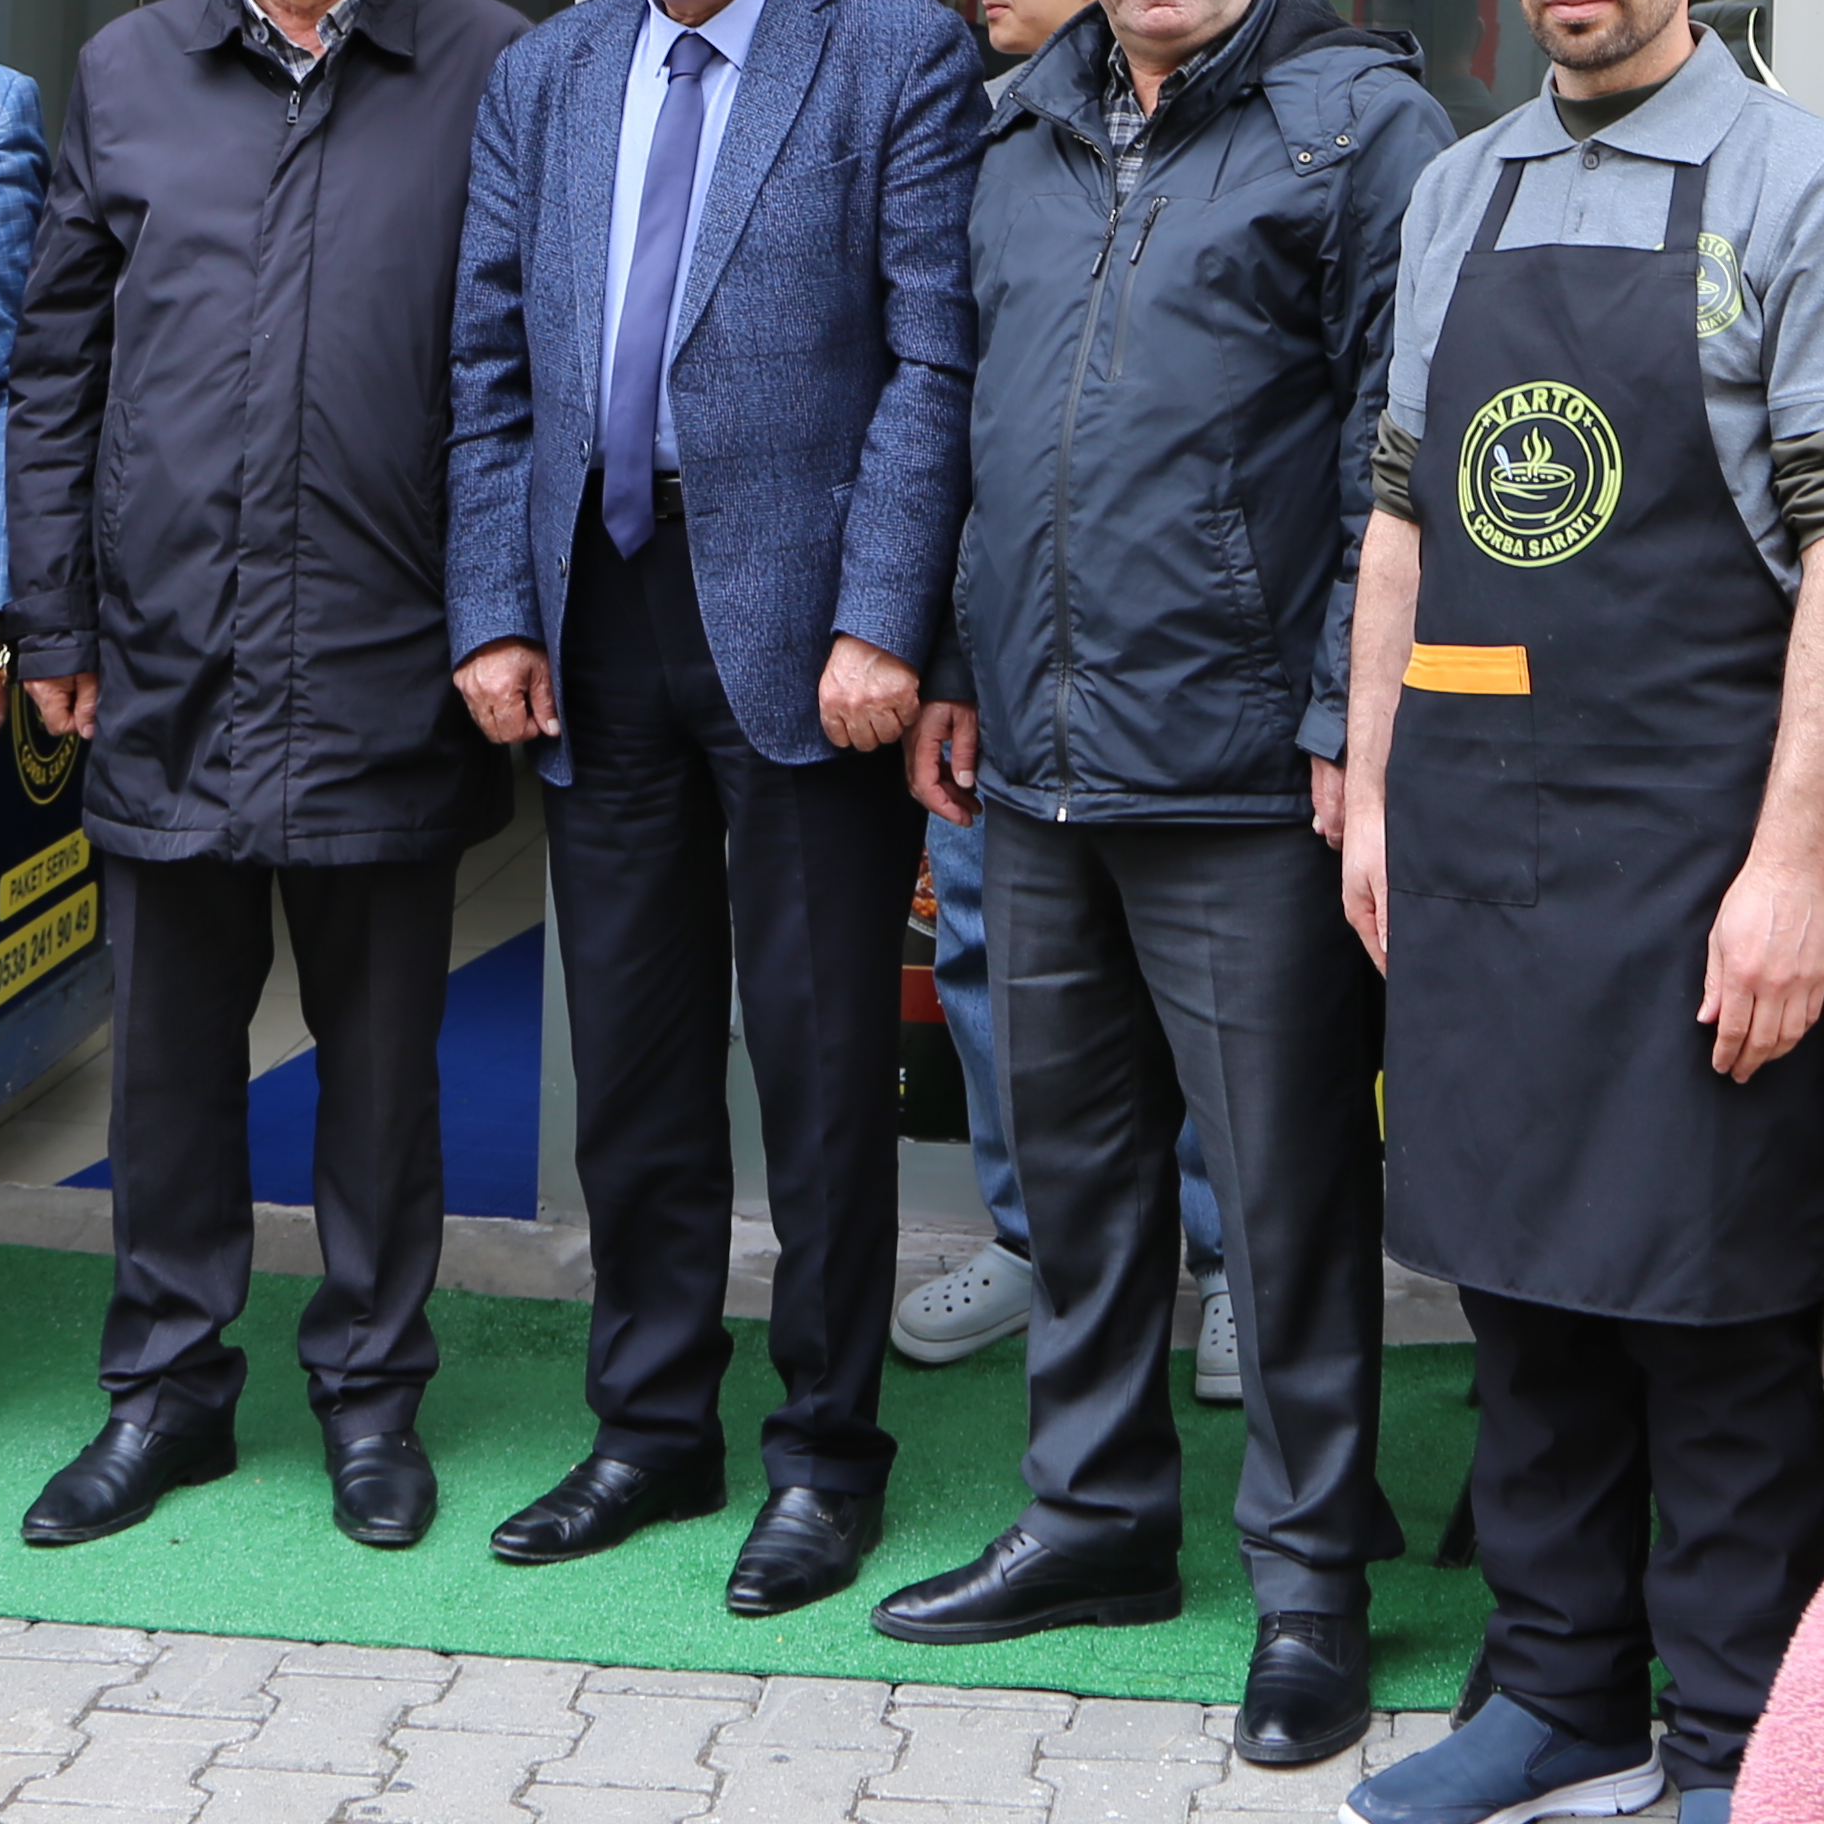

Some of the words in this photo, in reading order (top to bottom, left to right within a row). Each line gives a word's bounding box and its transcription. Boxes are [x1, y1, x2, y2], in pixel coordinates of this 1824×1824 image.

[1488, 387, 1585, 426] VARTO
[1473, 512, 1524, 558] ÇORBA
[1528, 512, 1596, 558] SARAYI
[10, 861, 44, 906] PAKET
[30, 922, 52, 967] 241
[57, 911, 72, 949] 90
[75, 899, 90, 933] 49
